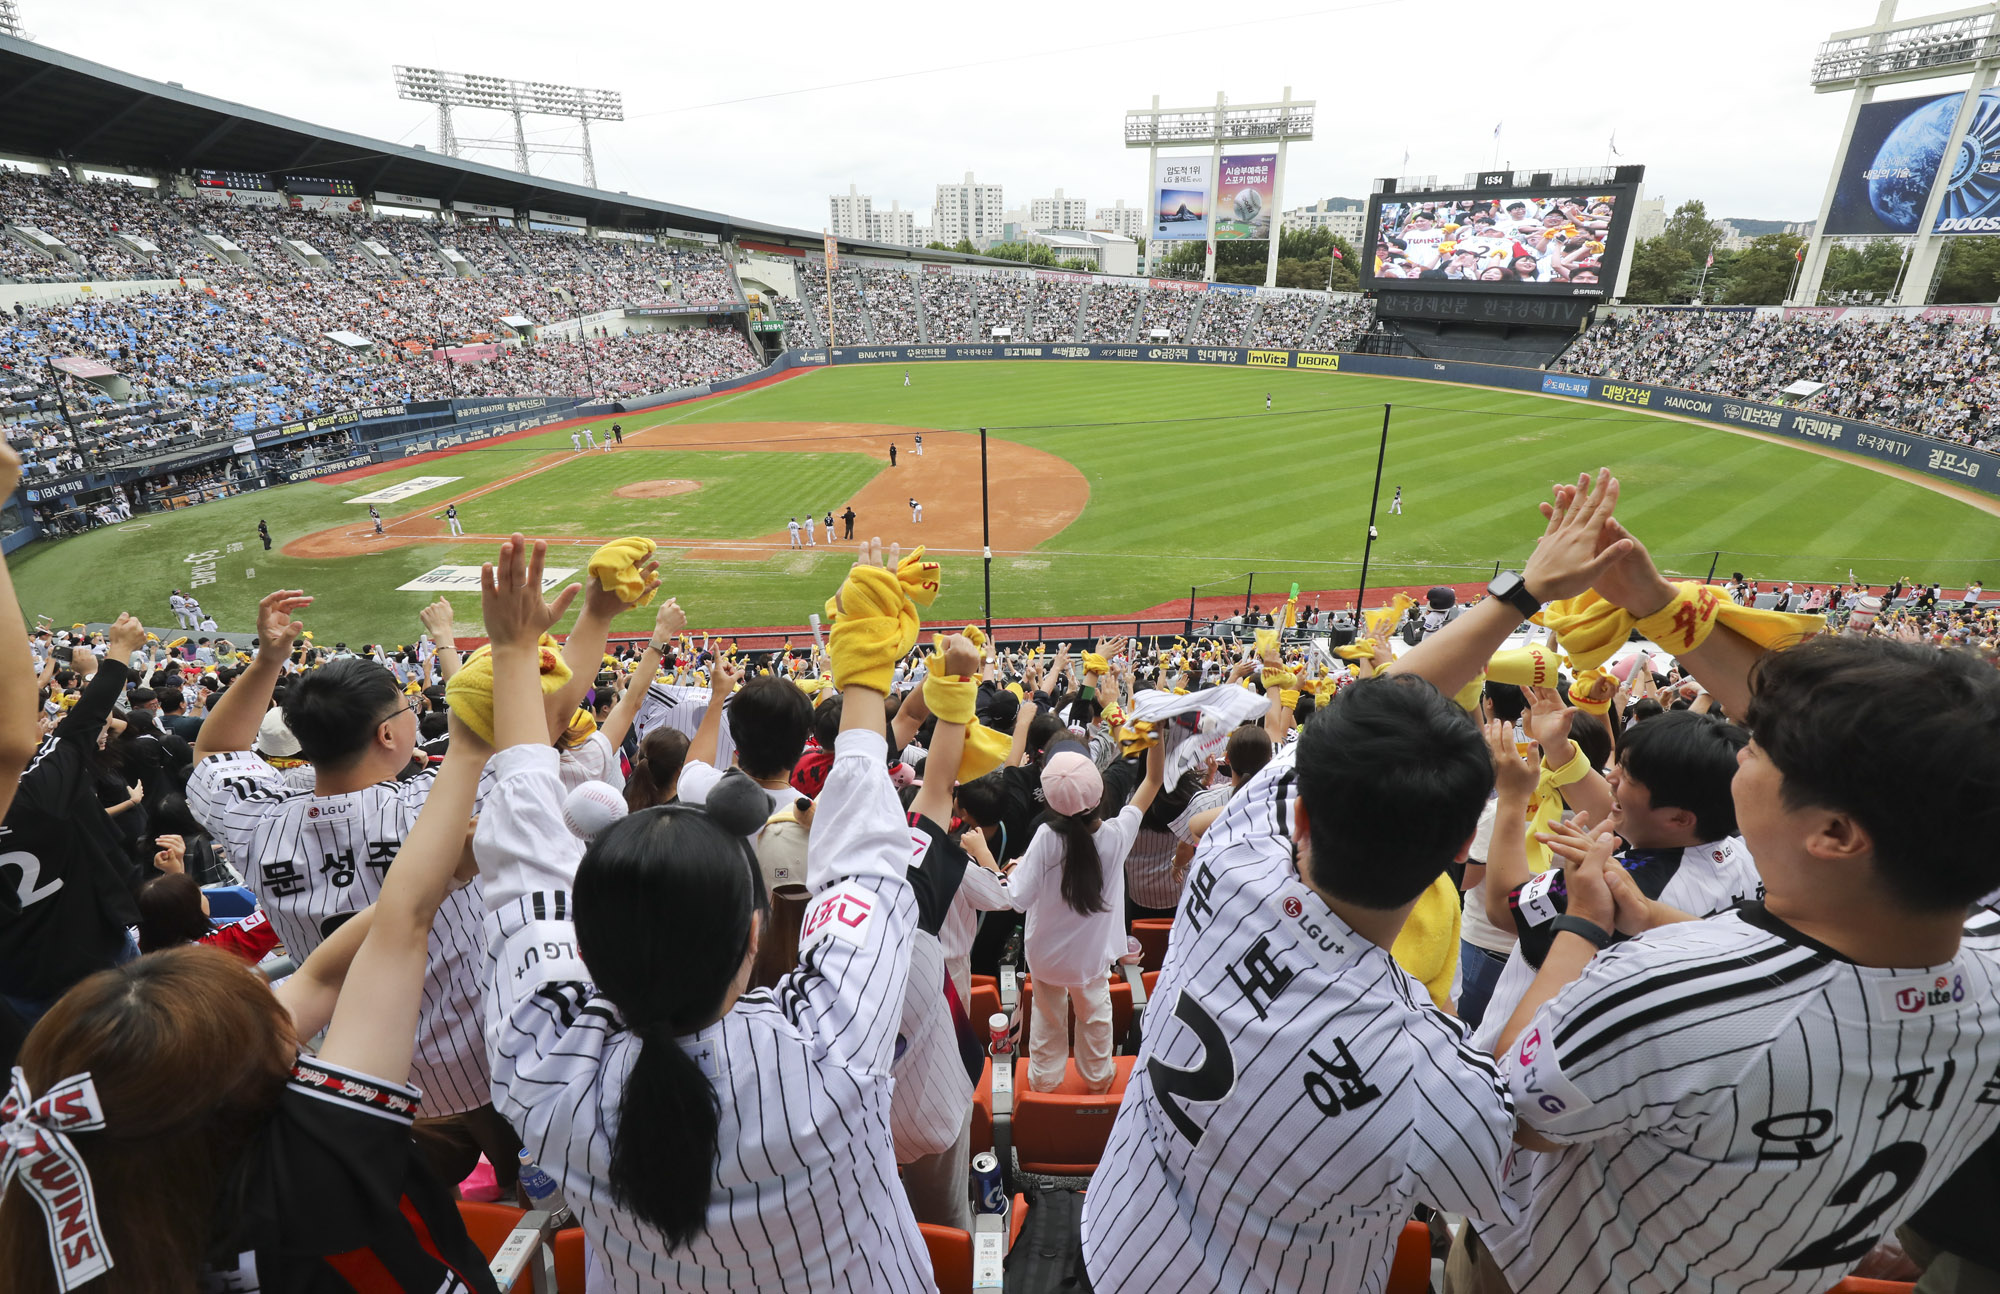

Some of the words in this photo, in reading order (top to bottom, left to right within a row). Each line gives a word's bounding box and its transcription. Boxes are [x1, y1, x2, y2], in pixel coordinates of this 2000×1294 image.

[1166, 166, 1188, 175] 압도적
[1189, 166, 1201, 175] 1위
[1225, 166, 1269, 175] AI승부예측은
[1862, 168, 1890, 180] 내일의
[1890, 167, 1912, 178] 기술.
[1224, 176, 1246, 184] 스포키
[1246, 176, 1268, 184] 앱에서
[1384, 297, 1469, 315] 한국경제신문
[1484, 299, 1577, 320] 한국경제TV
[914, 348, 947, 356] 유안타증권
[956, 348, 993, 356] 한국경제신문
[1161, 348, 1189, 360] 금강주택
[1197, 349, 1238, 363] 현대해상
[1298, 356, 1337, 367] UBORA
[1551, 381, 1588, 394] 도미노피자
[1602, 384, 1651, 406] 대방건설
[506, 398, 546, 412] 충남혁신도시
[1664, 396, 1712, 414] HANCOM
[1742, 406, 1782, 428] 대보건설
[1792, 416, 1844, 441] 치킨마루
[1857, 433, 1913, 458] 한국경제TV
[322, 806, 336, 816] LG
[338, 802, 352, 814] U+
[1529, 884, 1539, 900] LG
[1530, 899, 1548, 918] U+
[1298, 914, 1322, 939] LG
[1318, 934, 1346, 954] U+
[544, 942, 575, 960] LG
[514, 947, 540, 980] U+
[1145, 986, 1238, 1150] 2
[18, 1129, 96, 1269] TWINS
[1775, 1140, 1928, 1271] 2
